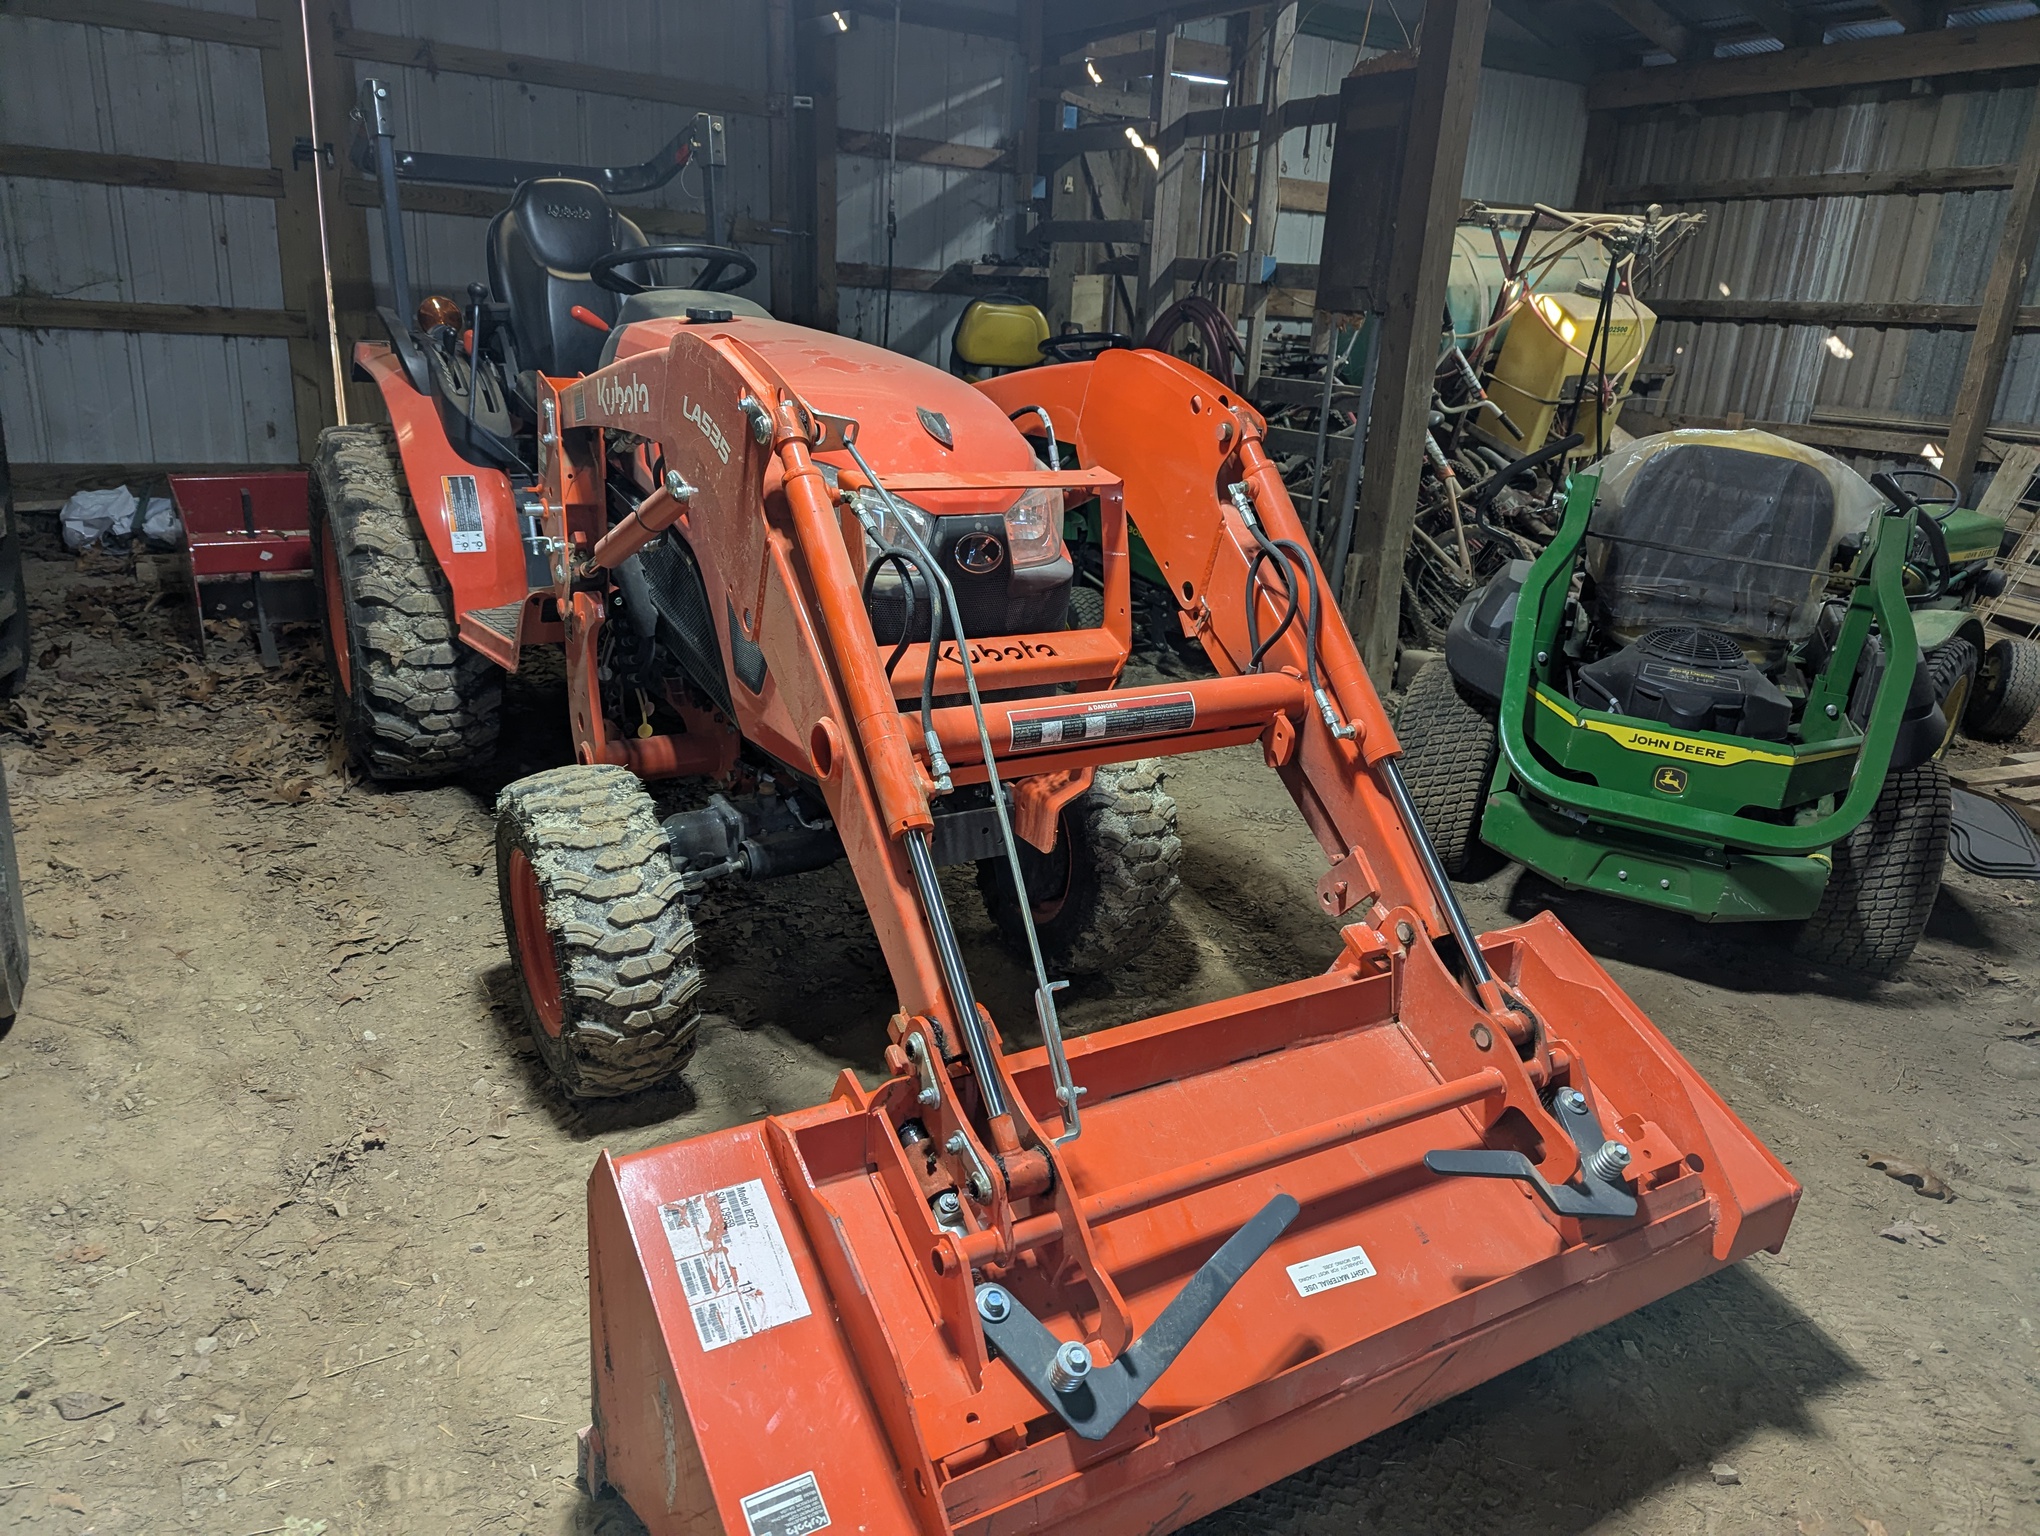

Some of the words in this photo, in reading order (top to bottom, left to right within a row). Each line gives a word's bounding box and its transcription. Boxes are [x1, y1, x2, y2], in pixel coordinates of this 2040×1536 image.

[597, 373, 649, 416] Kubota
[682, 395, 731, 465] LA535
[1628, 734, 1670, 749] JOHN
[1673, 741, 1726, 760] DEERE
[715, 1192, 727, 1204] S/N
[736, 1187, 751, 1207] Model
[1351, 1267, 1369, 1278] LIGHT
[1303, 1284, 1318, 1293] USE
[1318, 1274, 1350, 1288] MATERIAL
[803, 1490, 816, 1498] Model
[786, 1516, 827, 1535] Kubota
